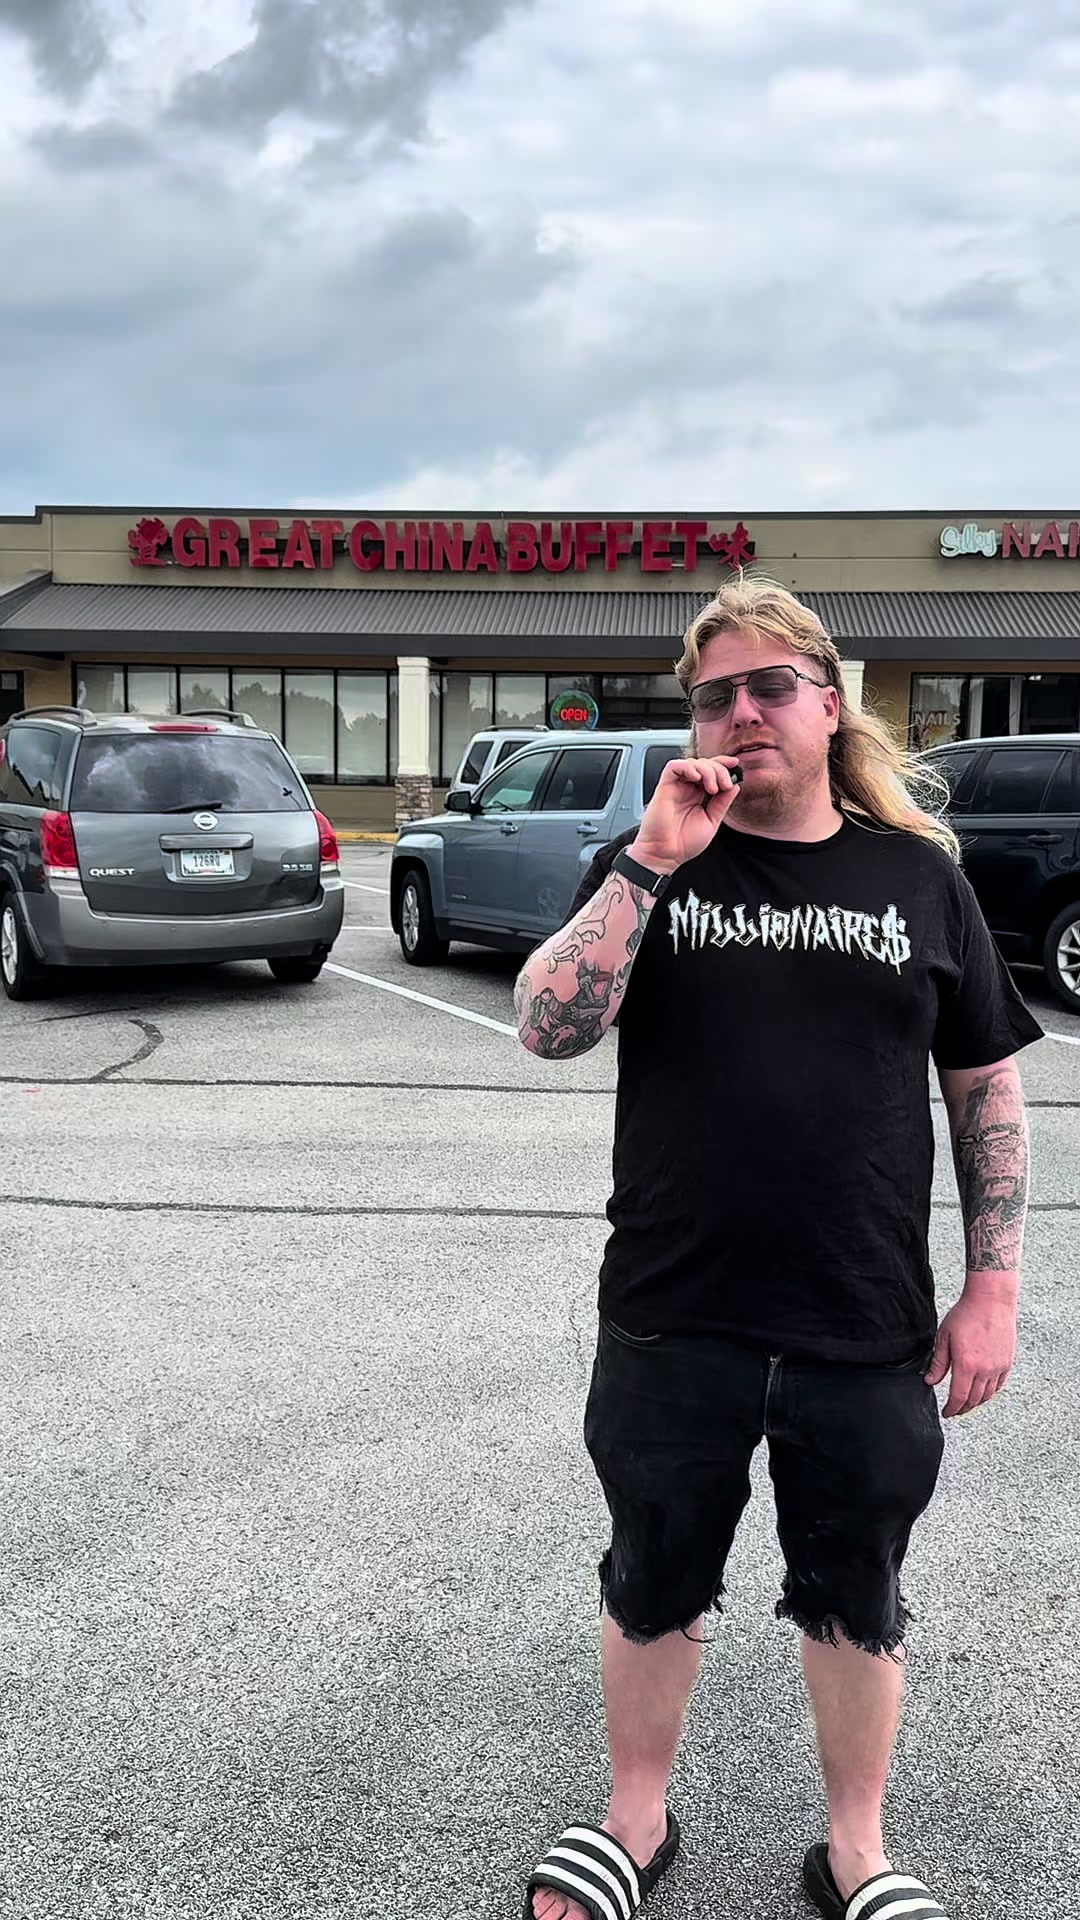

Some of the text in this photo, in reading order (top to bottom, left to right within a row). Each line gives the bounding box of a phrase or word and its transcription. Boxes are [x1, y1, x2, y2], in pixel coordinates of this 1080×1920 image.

[171, 516, 343, 569] GREAT
[349, 520, 499, 572] CHINA
[506, 521, 708, 572] BUFFET
[1002, 521, 1080, 558] NAI
[560, 707, 587, 721] OPEN
[915, 712, 961, 726] NAILS
[89, 867, 136, 878] QUEST
